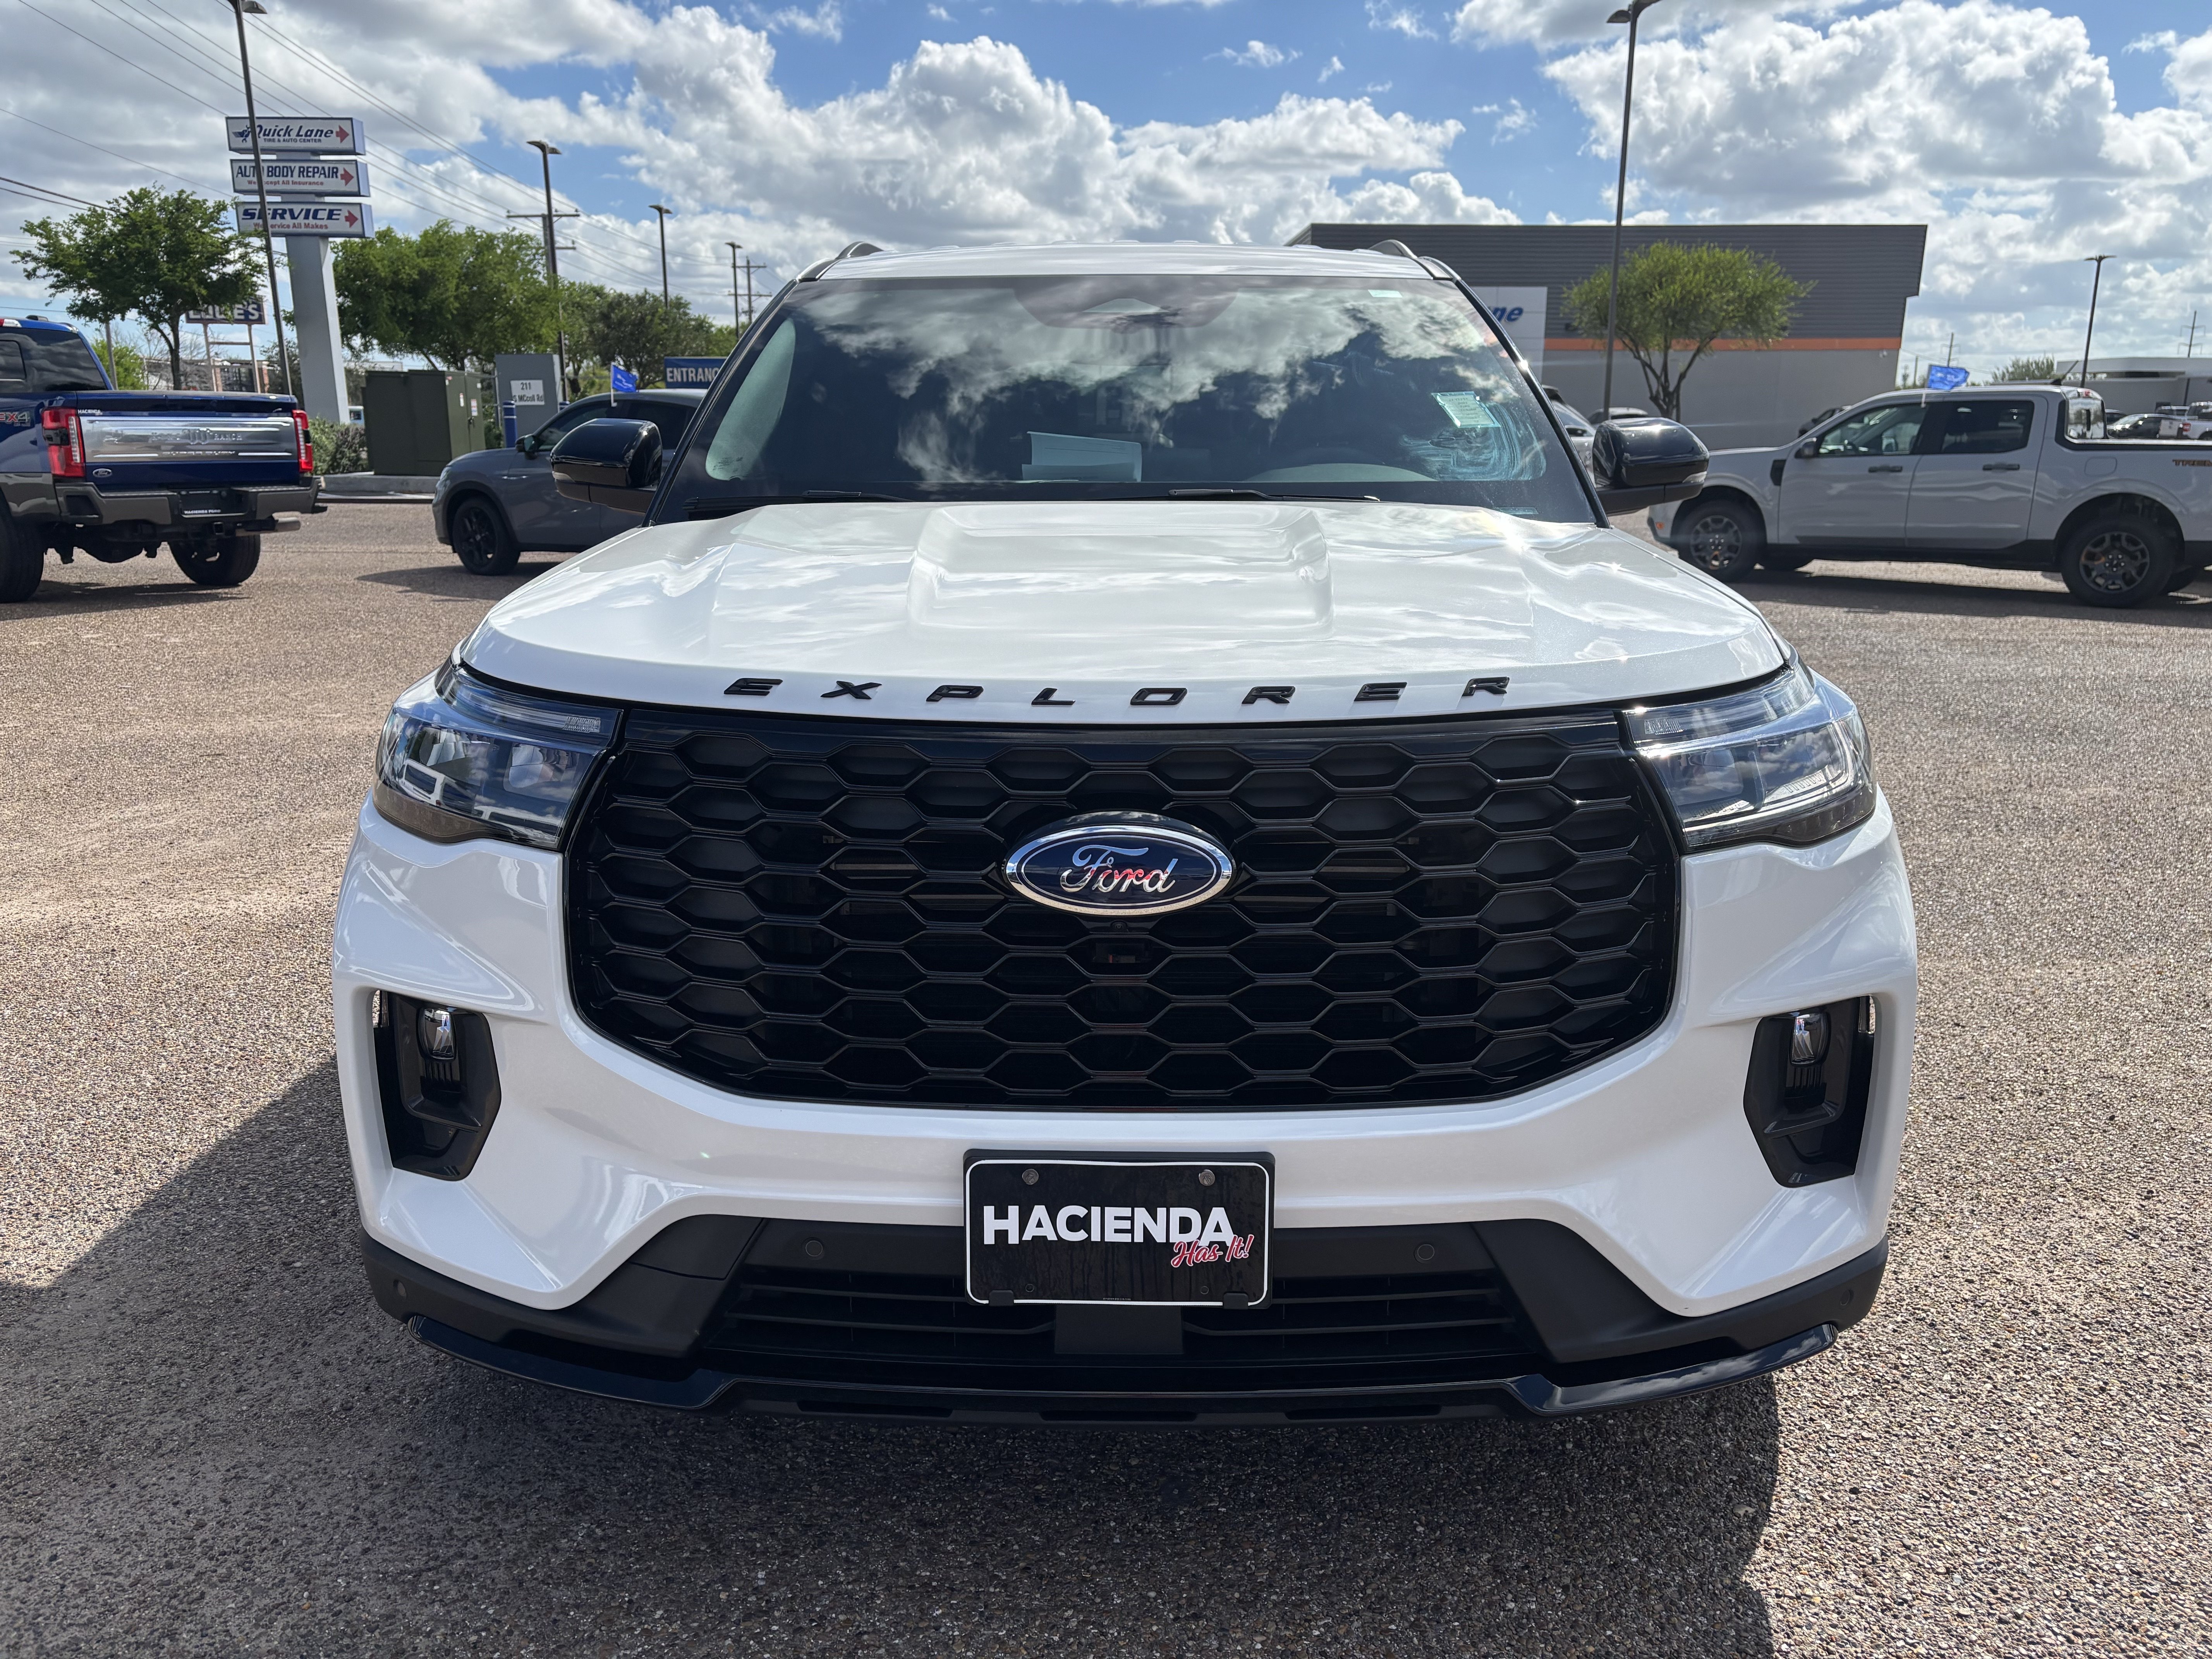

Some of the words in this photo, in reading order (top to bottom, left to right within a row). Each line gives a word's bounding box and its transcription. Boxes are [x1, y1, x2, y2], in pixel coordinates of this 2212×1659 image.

[257, 124, 293, 138] Quick
[295, 125, 333, 137] Lane
[236, 165, 264, 178] AUT
[267, 165, 296, 178] BODY
[298, 166, 339, 178] REPAIR
[242, 208, 342, 220] SERVICE
[1491, 306, 1524, 322] ne
[666, 368, 720, 382] ENTRANC
[520, 382, 531, 390] 211
[536, 393, 543, 402] Rd
[723, 677, 1510, 706] EXPLORER
[1060, 845, 1178, 892] Ford
[983, 1205, 1234, 1246] HACIENDA
[1171, 1240, 1223, 1267] Has
[1225, 1234, 1254, 1262] It!
